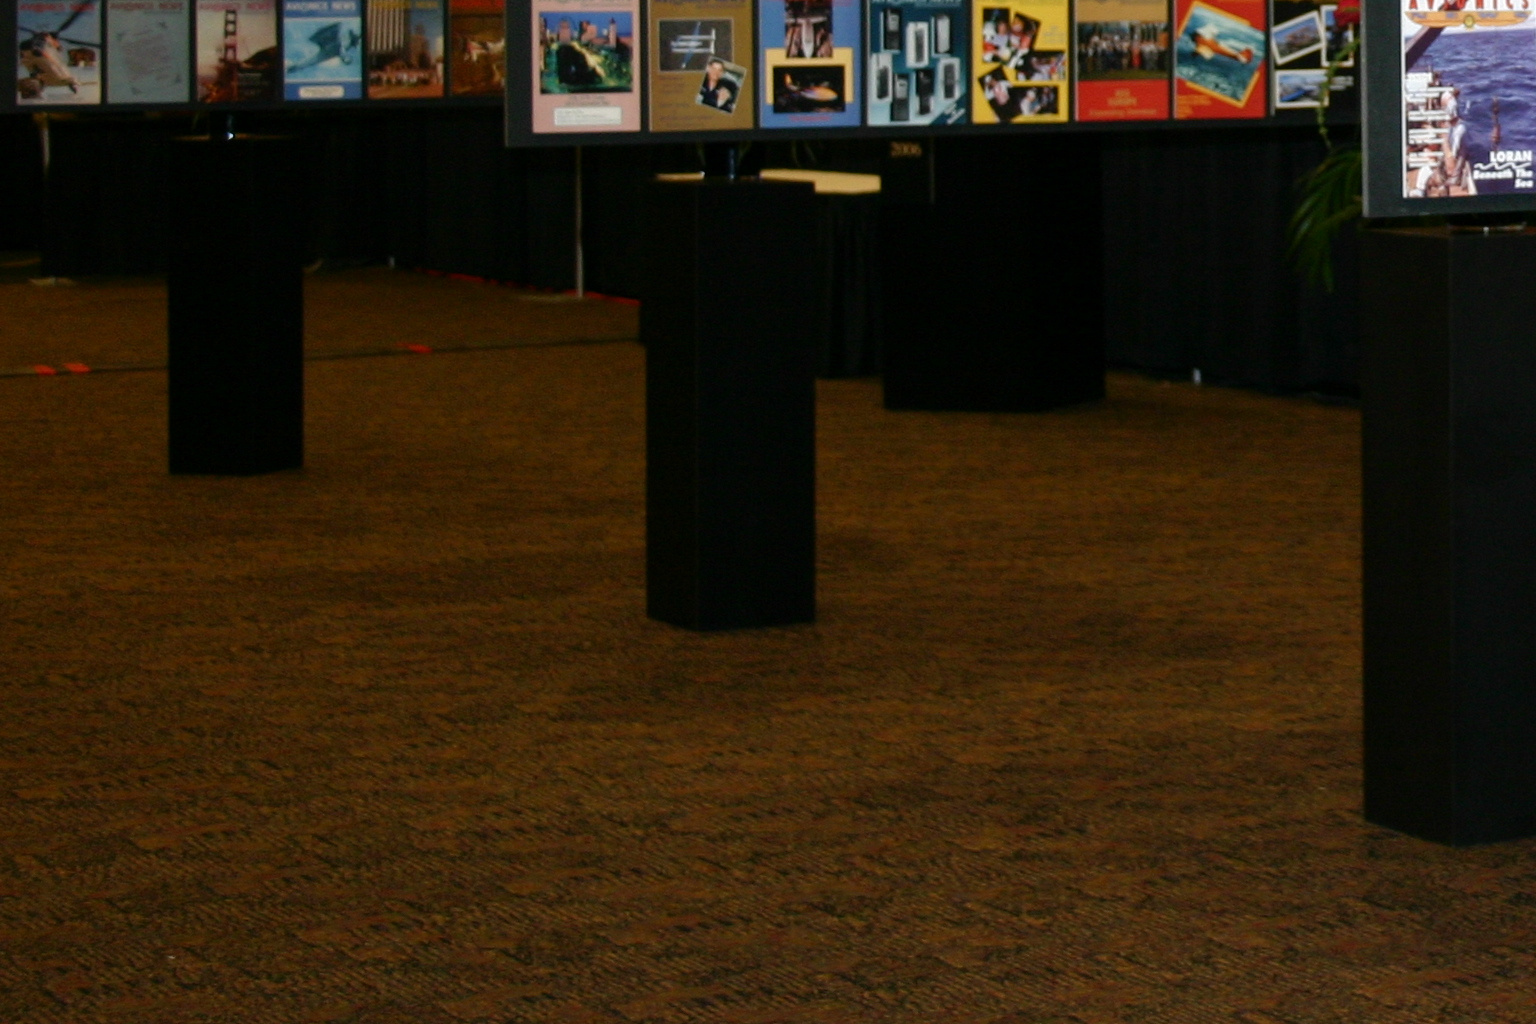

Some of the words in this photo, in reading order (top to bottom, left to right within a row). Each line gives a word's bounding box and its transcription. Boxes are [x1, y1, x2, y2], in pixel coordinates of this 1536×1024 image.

[1490, 151, 1532, 163] LORAN
[1473, 170, 1513, 180] Beneath
[1515, 169, 1533, 179] The
[1514, 178, 1533, 189] Sea
